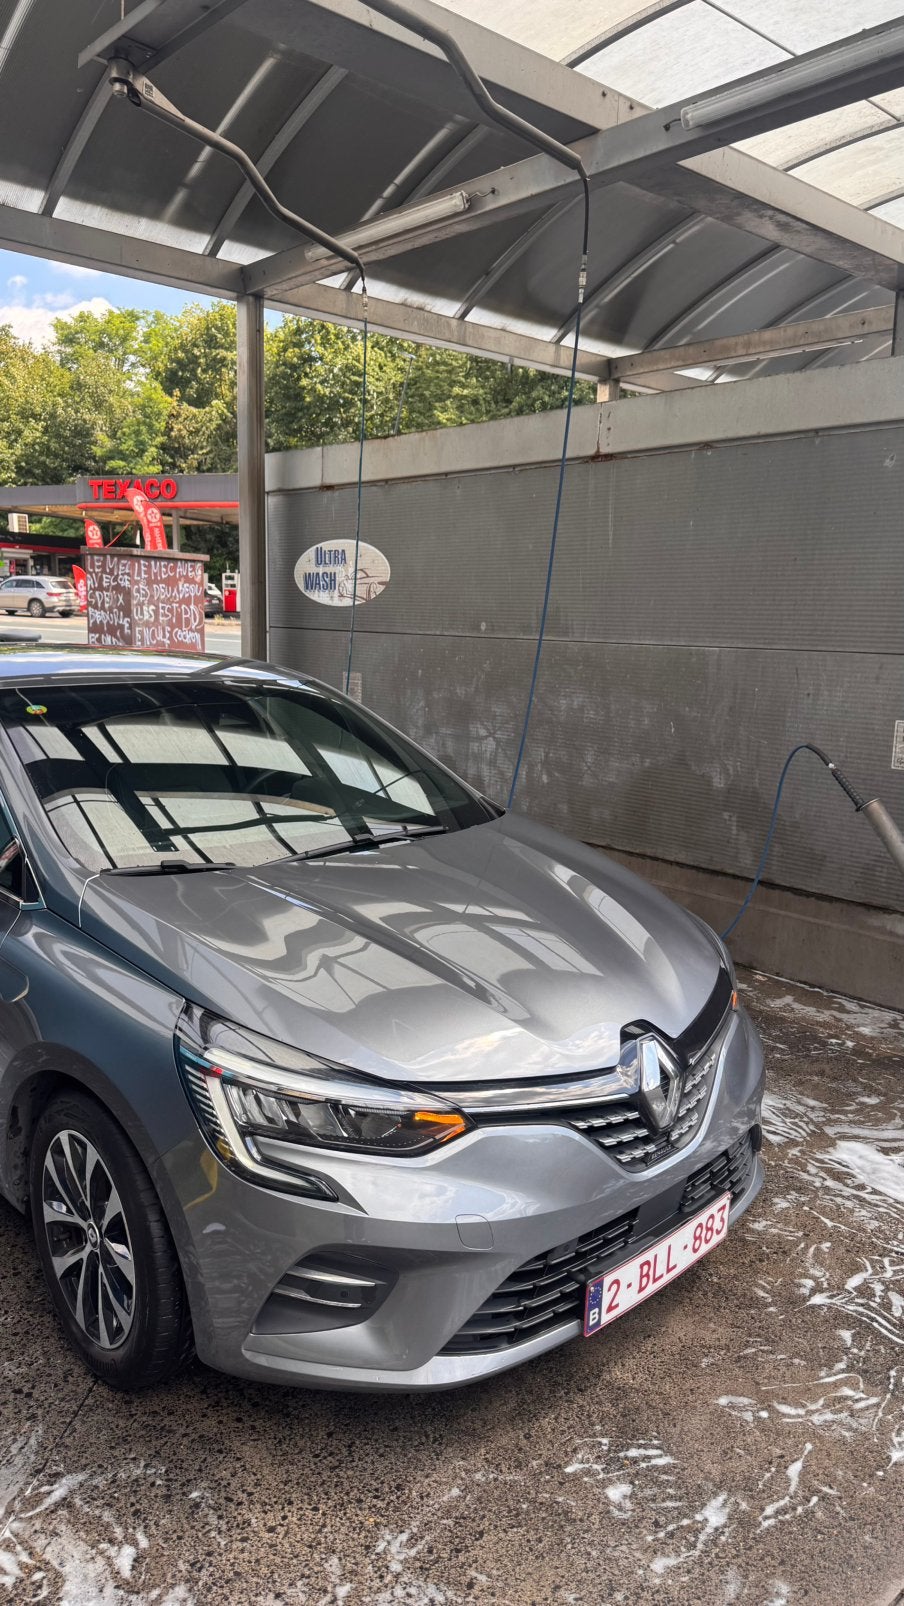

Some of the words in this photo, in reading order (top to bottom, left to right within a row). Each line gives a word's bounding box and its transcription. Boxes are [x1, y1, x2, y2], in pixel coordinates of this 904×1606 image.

[89, 478, 177, 499] TEXACO
[87, 555, 103, 572] LE
[315, 547, 347, 567] ULTRA
[134, 560, 149, 580] LE
[151, 560, 175, 580] MEC
[304, 572, 337, 592] WASH
[159, 602, 179, 623] EST
[589, 1307, 600, 1327] B
